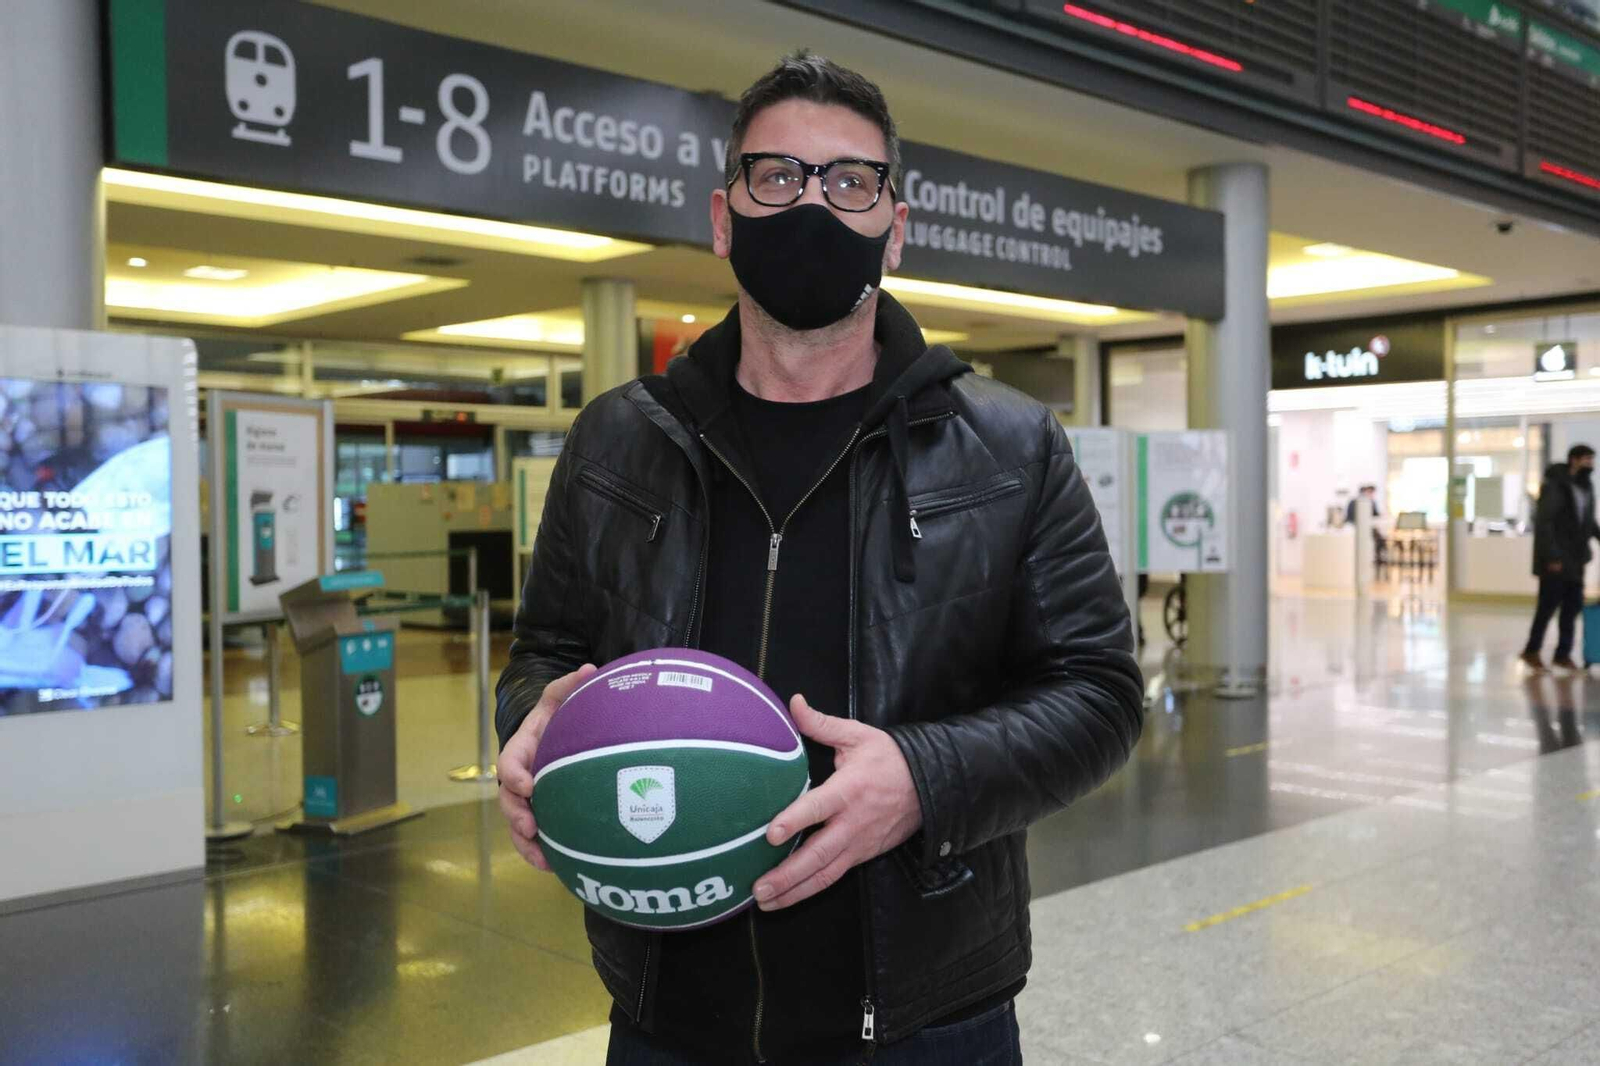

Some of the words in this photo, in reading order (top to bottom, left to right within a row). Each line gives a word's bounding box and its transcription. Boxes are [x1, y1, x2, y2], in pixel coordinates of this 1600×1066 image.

[347, 57, 492, 175] 1-8
[522, 91, 664, 159] Acceso
[677, 132, 700, 168] a
[523, 155, 685, 208] PLATFORMS
[904, 170, 1005, 224] Control
[1012, 192, 1045, 232] de
[1052, 206, 1163, 258] equipajes
[905, 220, 994, 258] LUGGAGE
[995, 235, 1072, 271] CONTROL
[0, 491, 40, 511] QUE
[0, 511, 34, 531] NO
[2, 541, 48, 567] EL
[64, 539, 150, 565] MAR
[629, 803, 664, 814] Unicaja
